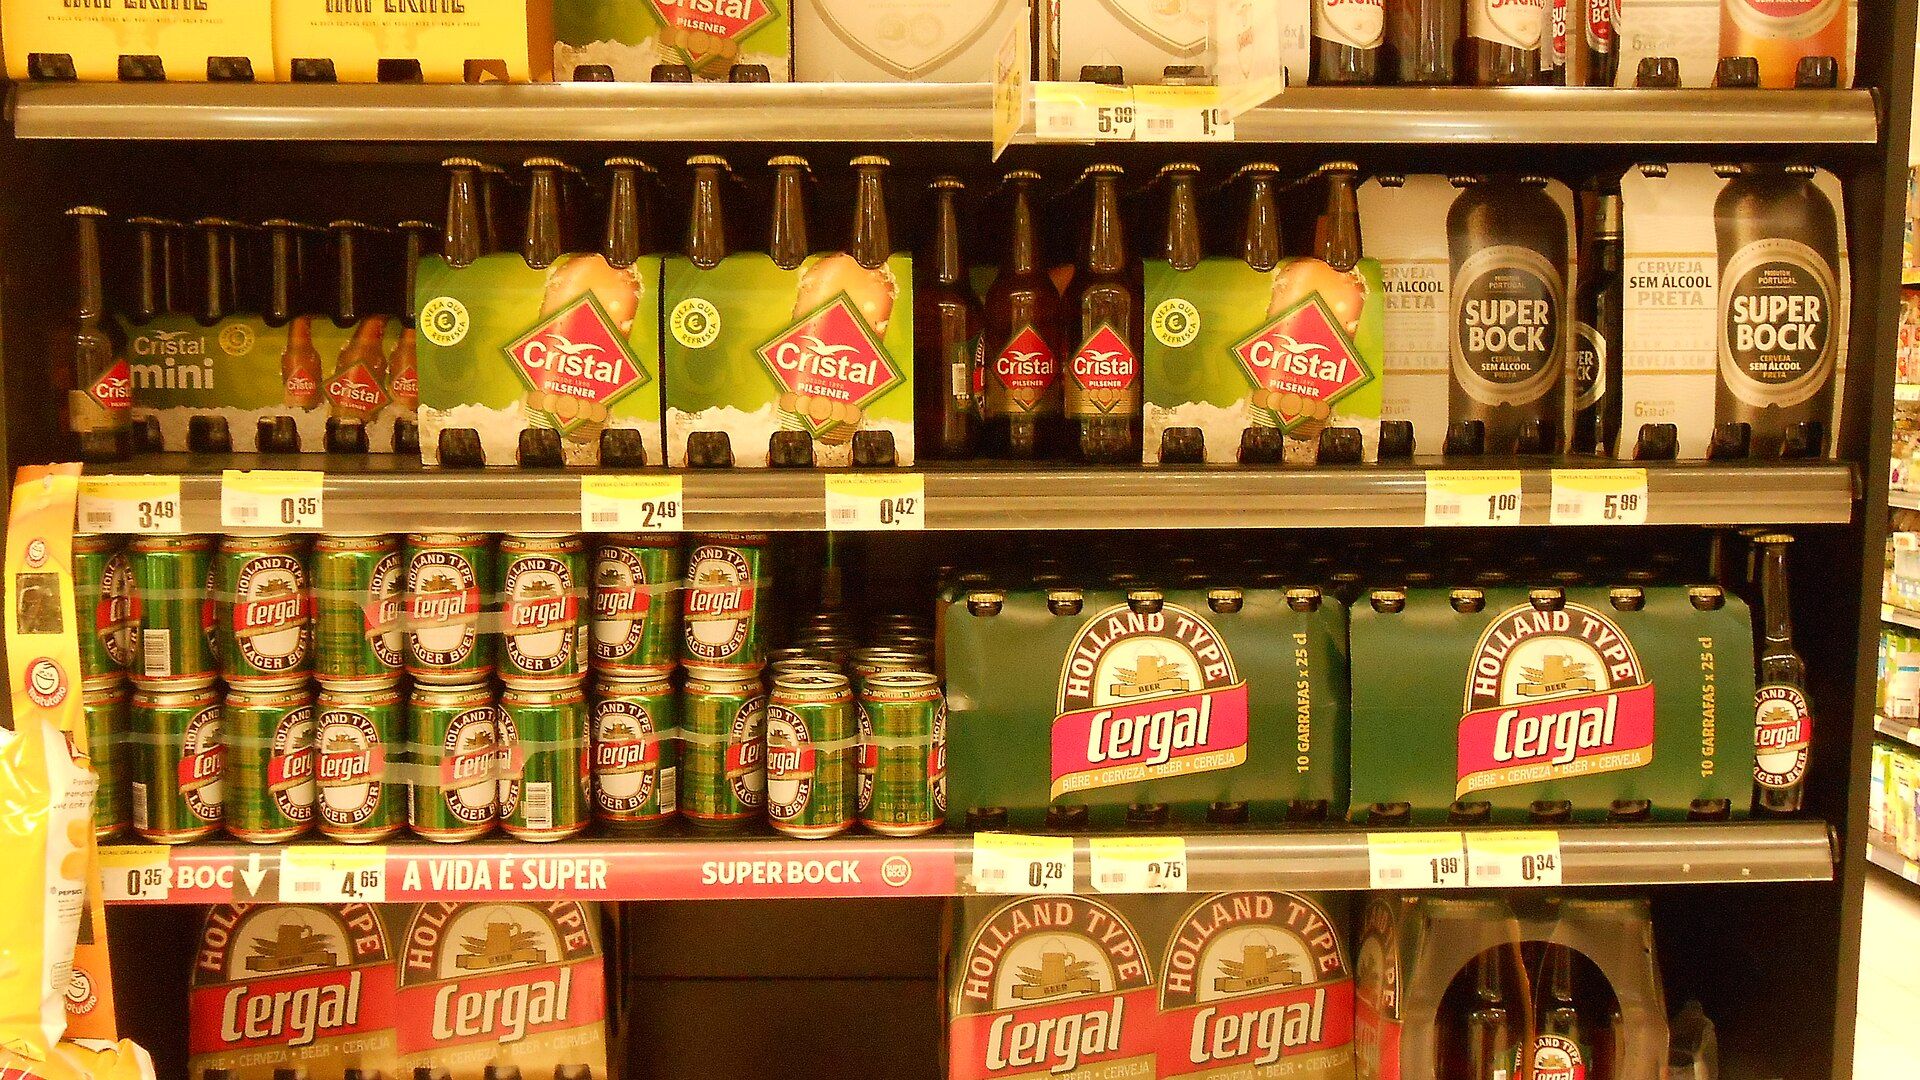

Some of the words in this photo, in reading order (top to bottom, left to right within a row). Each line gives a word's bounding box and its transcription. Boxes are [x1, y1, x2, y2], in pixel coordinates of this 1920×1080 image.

[676, 17, 727, 35] PILSENER
[1629, 277, 1659, 289] SEM
[1661, 273, 1712, 289] ÁLCOOL
[1637, 261, 1703, 274] CERVEJA
[1758, 277, 1797, 285] PORTUGAL
[1637, 290, 1704, 306] PRETA
[1733, 295, 1821, 323] SUPER
[425, 301, 444, 328] LEVEZA
[447, 301, 463, 316] QUE
[675, 302, 694, 329] LEVEZA
[697, 302, 714, 318] QUE
[1156, 302, 1176, 329] LEVEZA
[1177, 303, 1196, 318] QUE
[1465, 300, 1549, 326] SUPER
[431, 321, 465, 342] REFRESCA
[681, 322, 717, 344] REFRESCA
[1162, 322, 1198, 344] REFRESCA
[1469, 326, 1546, 352] BOCK
[1736, 323, 1817, 351] BOCK
[134, 336, 205, 356] Cristal
[130, 357, 214, 389] mini
[522, 341, 623, 385] Cristal
[775, 342, 878, 387] Cristal
[996, 357, 1053, 376] Cristal
[1073, 356, 1133, 376] Cristal
[1249, 340, 1348, 384] Cristal
[1481, 363, 1499, 371] SEM
[1749, 362, 1768, 371] SEM
[1768, 360, 1802, 371] ÁLCOOL
[329, 381, 380, 405] Cristal
[543, 380, 596, 399] PILSENER
[797, 382, 851, 401] PILSENER
[1269, 378, 1320, 397] PILSENER
[138, 501, 174, 530] 3,49
[281, 497, 317, 525] 0,35
[641, 501, 677, 529] 2,49
[879, 497, 915, 526] 0,42
[1488, 494, 1517, 521] 1,00
[1604, 494, 1638, 520] 5,99
[238, 558, 282, 597] HOLLAND
[408, 553, 446, 591] HOLLAND
[450, 555, 472, 583] TYPE
[505, 560, 546, 596] HOLLAND
[549, 563, 570, 589] TYPE
[621, 552, 643, 581] TYPE
[687, 549, 724, 583] HOLLAND
[727, 551, 749, 581] TYPE
[246, 593, 301, 627] Cergal
[413, 590, 467, 623] Cergal
[511, 596, 566, 628] Cergal
[690, 588, 742, 616] Cergal
[410, 633, 445, 664] LAGER
[450, 626, 476, 663] BEER
[507, 640, 544, 670] LAGER
[550, 632, 573, 669] BEER
[615, 623, 643, 657] BEER
[686, 627, 716, 657] LAGER
[720, 622, 747, 657] BEER
[242, 641, 283, 669] LAGER
[1066, 612, 1166, 699] HOLLAND
[1175, 615, 1229, 683] TYPE
[1296, 648, 1310, 668] 25
[1474, 610, 1570, 698] HOLLAND
[1581, 616, 1635, 683] TYPE
[1700, 652, 1715, 672] 25
[1138, 682, 1161, 693] BEER
[1299, 669, 1310, 678] x
[1544, 682, 1567, 692] BEER
[1705, 673, 1714, 682] x
[1296, 680, 1310, 752] GARRAFAS
[1788, 690, 1808, 717] TYPE
[352, 715, 377, 744] TYPE
[445, 710, 487, 751] HOLLAND
[628, 704, 652, 734] TYPE
[785, 709, 808, 742] TYPE
[1087, 694, 1212, 766] Cergal
[1493, 694, 1618, 766] Cergal
[1701, 684, 1715, 757] GARRAFAS
[1754, 720, 1801, 749] Cergal
[320, 750, 371, 781] Cergal
[1102, 767, 1146, 784] CERVEZA
[1156, 761, 1183, 775] BEER
[1193, 754, 1236, 769] CERVEJA
[1296, 756, 1310, 773] 10
[1507, 767, 1551, 783] CERVEZA
[1562, 760, 1588, 774] BEER
[1599, 753, 1641, 769] CERVEJA
[1700, 760, 1714, 778] 10
[1787, 748, 1807, 783] BEER
[353, 786, 380, 822] BEER
[629, 774, 653, 808] BEER
[785, 783, 810, 818] BEER
[277, 794, 312, 819] LAGER
[449, 795, 486, 822] LAGER
[402, 858, 423, 892] A
[429, 858, 492, 892] VIDA
[521, 858, 608, 891] SUPER
[701, 860, 783, 886] SUPER
[786, 859, 862, 885] BOCK
[1028, 861, 1064, 888] 0,28
[1430, 857, 1458, 884] 1,99
[1522, 854, 1556, 882] 0,34
[127, 868, 162, 897] 0,35
[341, 870, 379, 899] 4,65
[966, 902, 1074, 1000] HOLLAND
[1087, 909, 1142, 982] TYPE
[1168, 895, 1274, 994] HOLLAND
[1287, 901, 1341, 972] TYPE
[1043, 983, 1069, 995] BEER
[1245, 976, 1271, 986] BEER
[220, 971, 362, 1047] Cergal
[431, 966, 571, 1044] Cergal
[985, 997, 1124, 1073] Cergal
[1189, 989, 1325, 1068] Cergal
[238, 1049, 288, 1068] CERVEZA
[300, 1043, 330, 1060] BEER
[343, 1036, 390, 1055] CERVEJA
[449, 1046, 500, 1064] CERVEZA
[510, 1039, 540, 1057] BEER
[553, 1033, 600, 1052] CERVEJA
[1562, 1041, 1581, 1065] TYPE
[1102, 1062, 1150, 1080] CERVEJA
[1265, 1062, 1296, 1080] BEER
